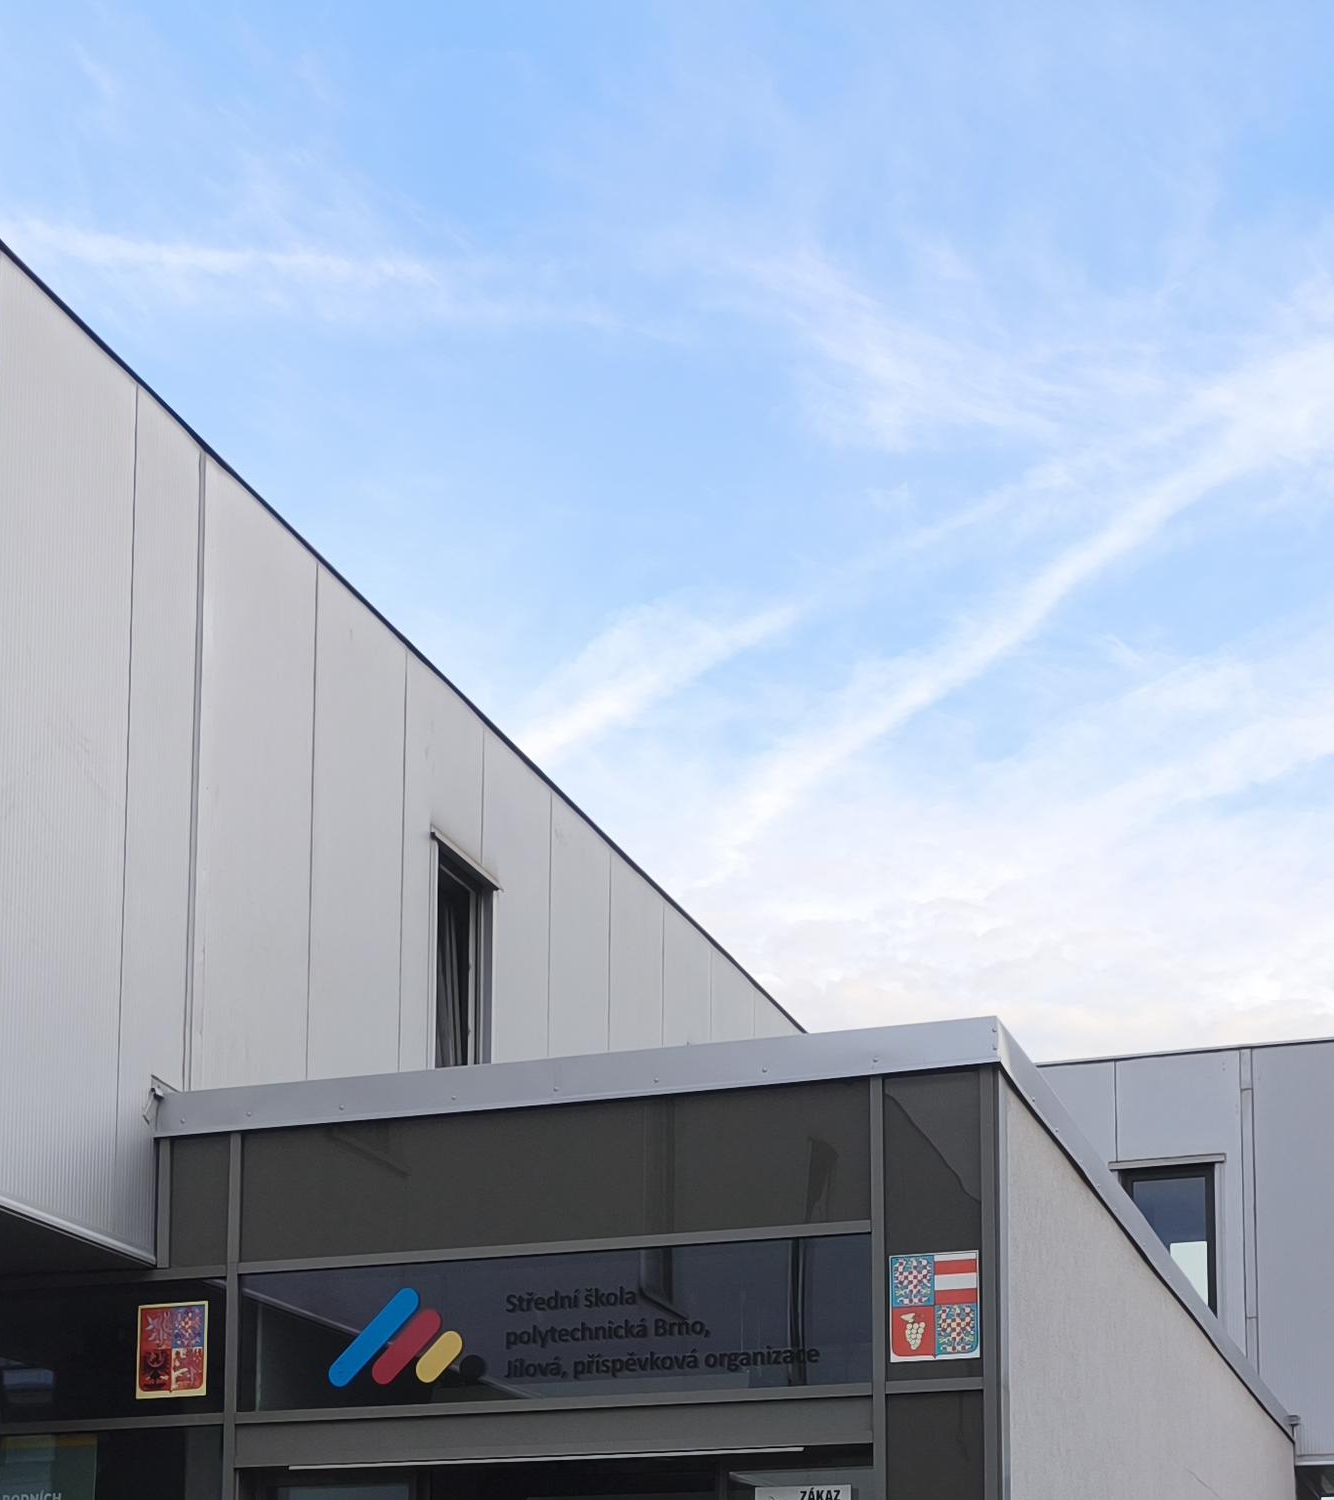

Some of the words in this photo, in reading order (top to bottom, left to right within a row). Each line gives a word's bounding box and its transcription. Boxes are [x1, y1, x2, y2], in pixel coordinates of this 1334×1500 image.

[505, 1288, 580, 1313] Střední
[583, 1286, 637, 1309] škola
[505, 1319, 648, 1349] polytechnická
[654, 1318, 711, 1339] Brno,
[504, 1356, 569, 1379] Jílová,
[573, 1349, 700, 1379] příspěvková
[704, 1345, 820, 1372] organizace
